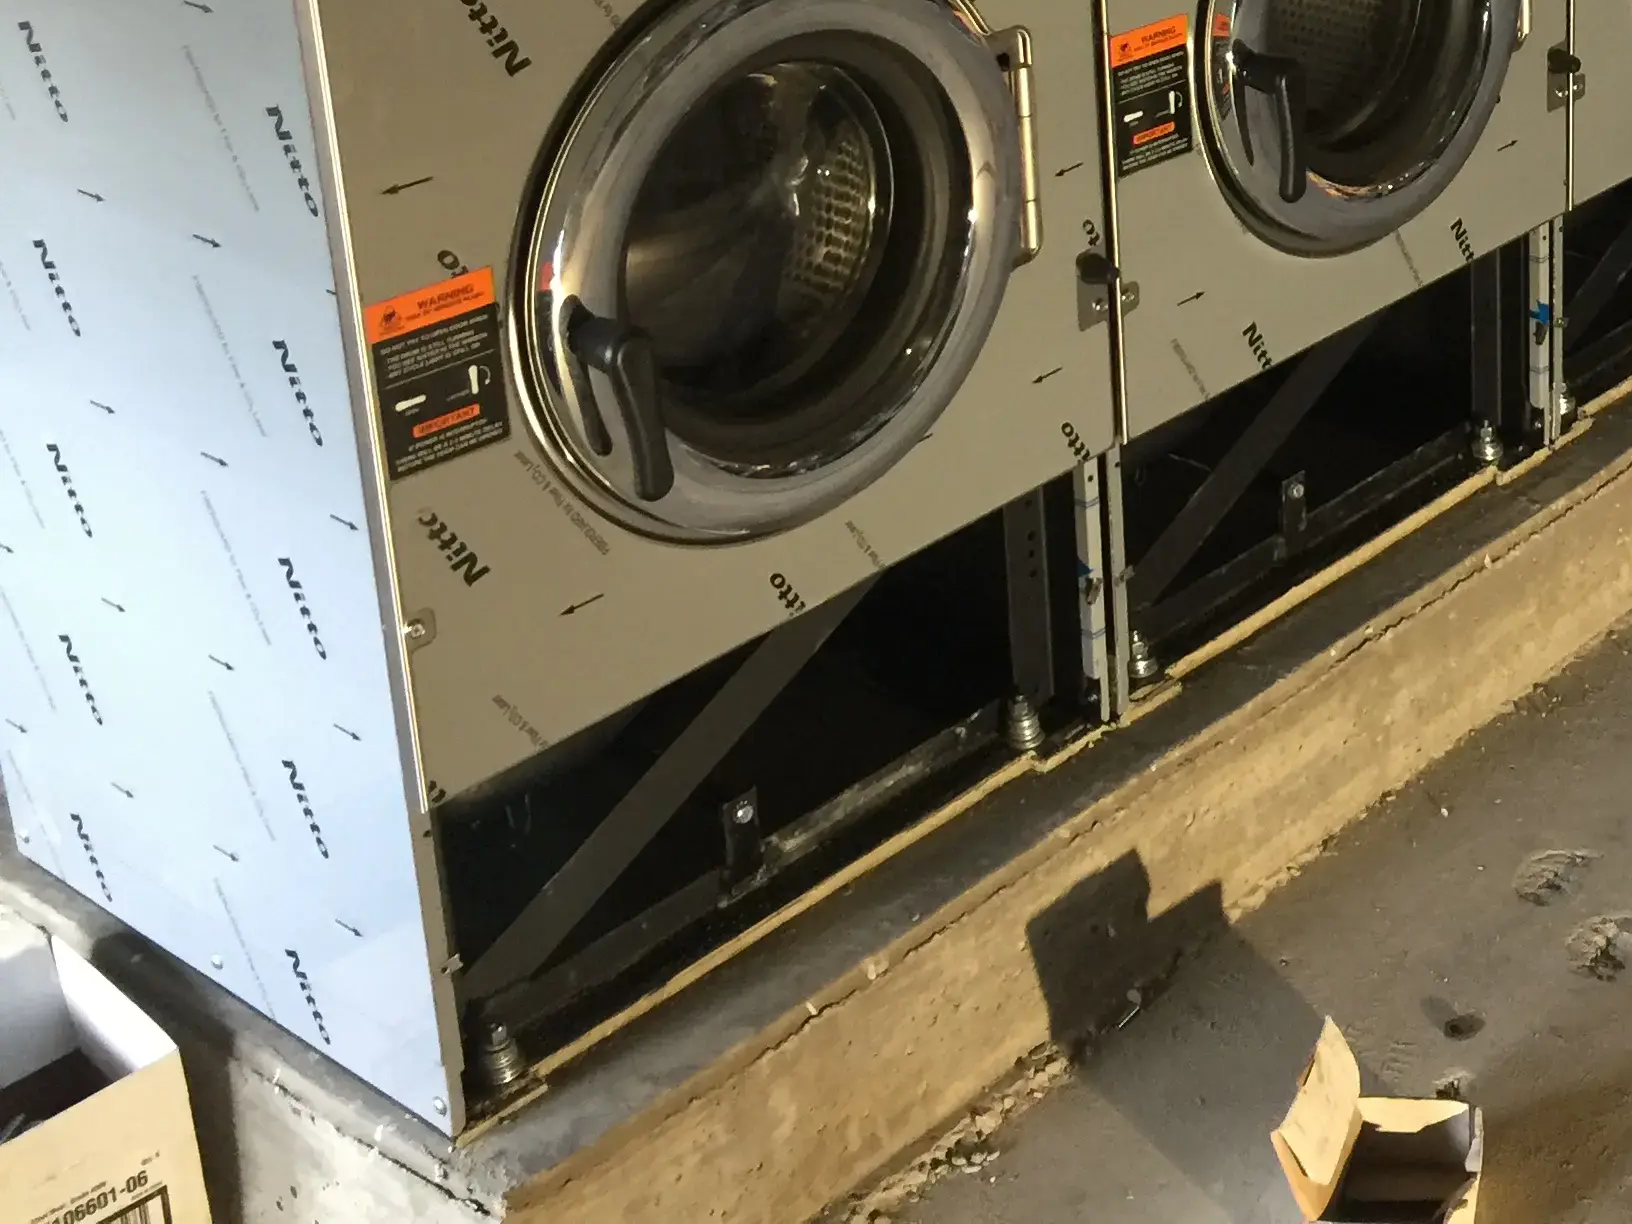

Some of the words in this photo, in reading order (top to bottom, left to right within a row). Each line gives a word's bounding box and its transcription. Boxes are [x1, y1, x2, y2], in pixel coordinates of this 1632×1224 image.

[18, 21, 68, 122] Nitto
[266, 104, 319, 217] Nitto
[1450, 217, 1476, 262] Nitt
[33, 240, 80, 336] Nitto
[416, 282, 474, 310] WARNING
[1242, 322, 1273, 369] Nitt
[272, 340, 322, 446] Nitto
[1061, 421, 1091, 462] itto
[47, 444, 92, 537] Nitto
[278, 558, 326, 659] Nitto
[769, 571, 806, 618] itto
[59, 635, 102, 725] Nitto
[282, 760, 328, 858] Nitto
[70, 812, 113, 903] Nitto
[285, 948, 330, 1046] Nitto
